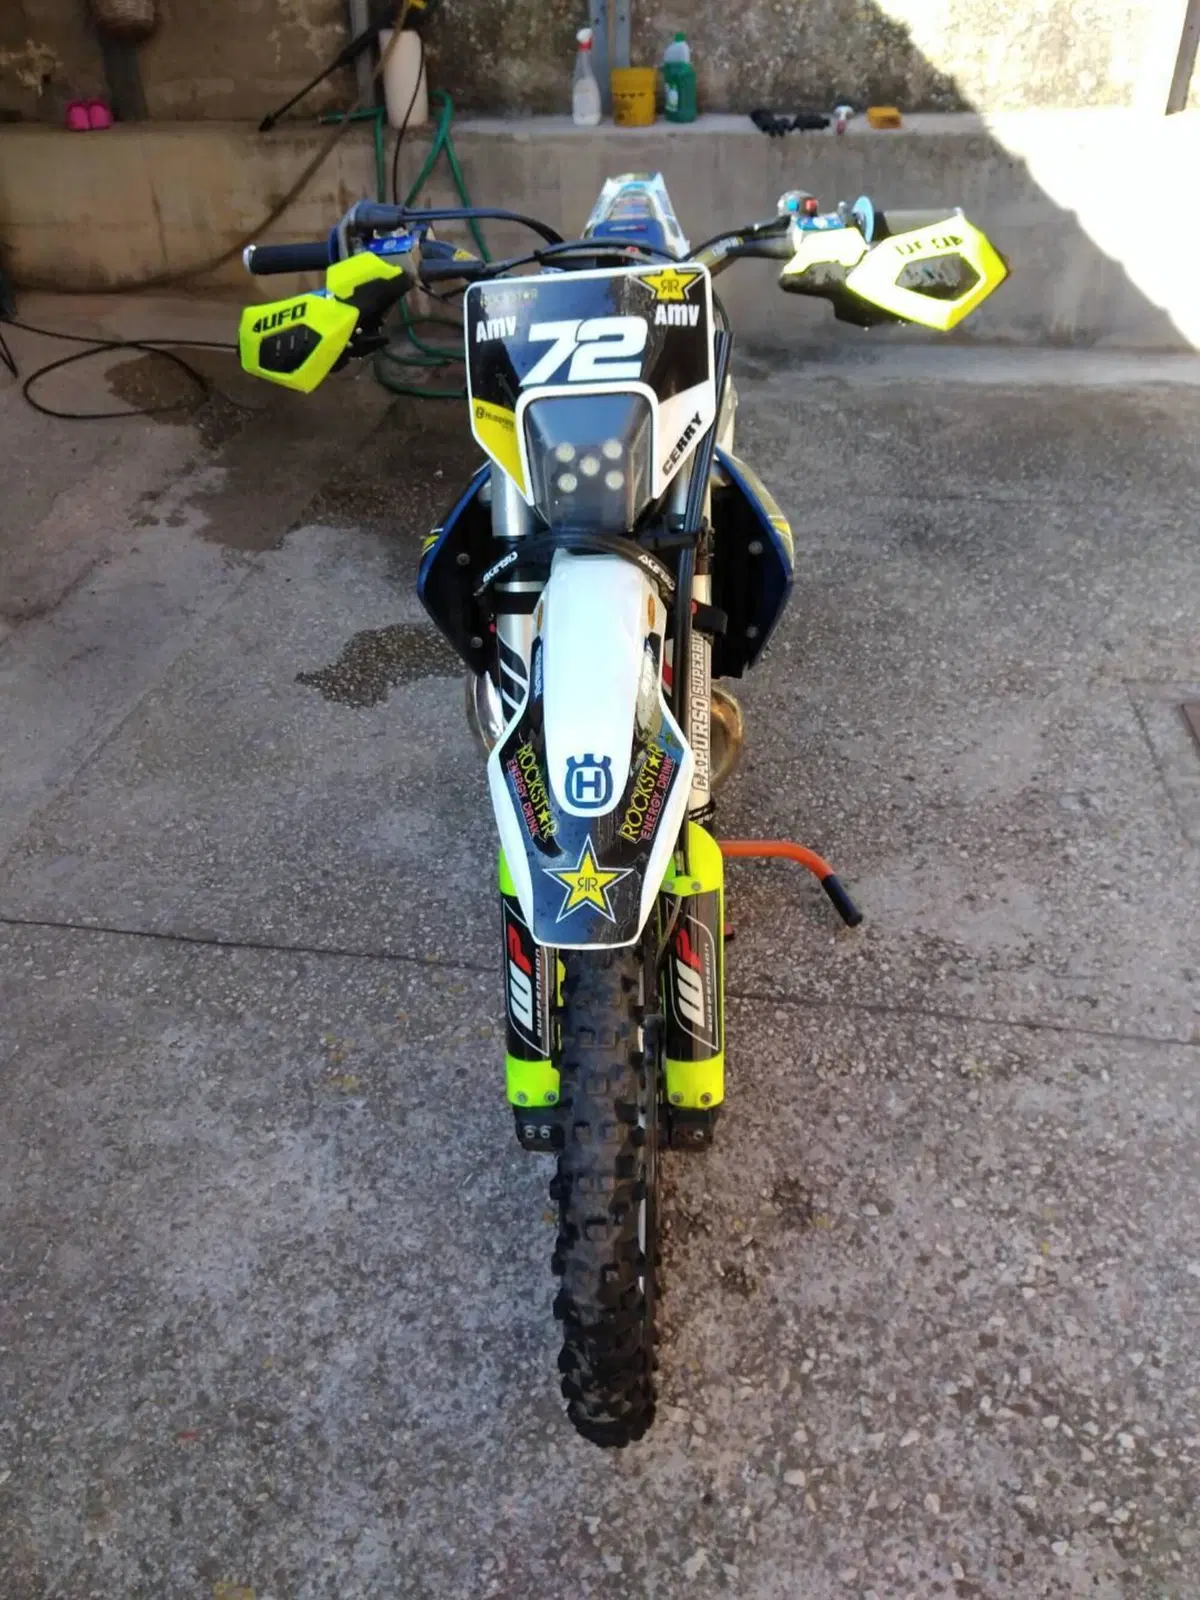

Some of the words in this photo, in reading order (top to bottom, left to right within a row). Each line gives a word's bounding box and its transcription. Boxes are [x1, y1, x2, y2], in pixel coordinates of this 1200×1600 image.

[261, 302, 307, 333] UFO
[519, 315, 648, 387] 72
[662, 411, 703, 478] CERRY
